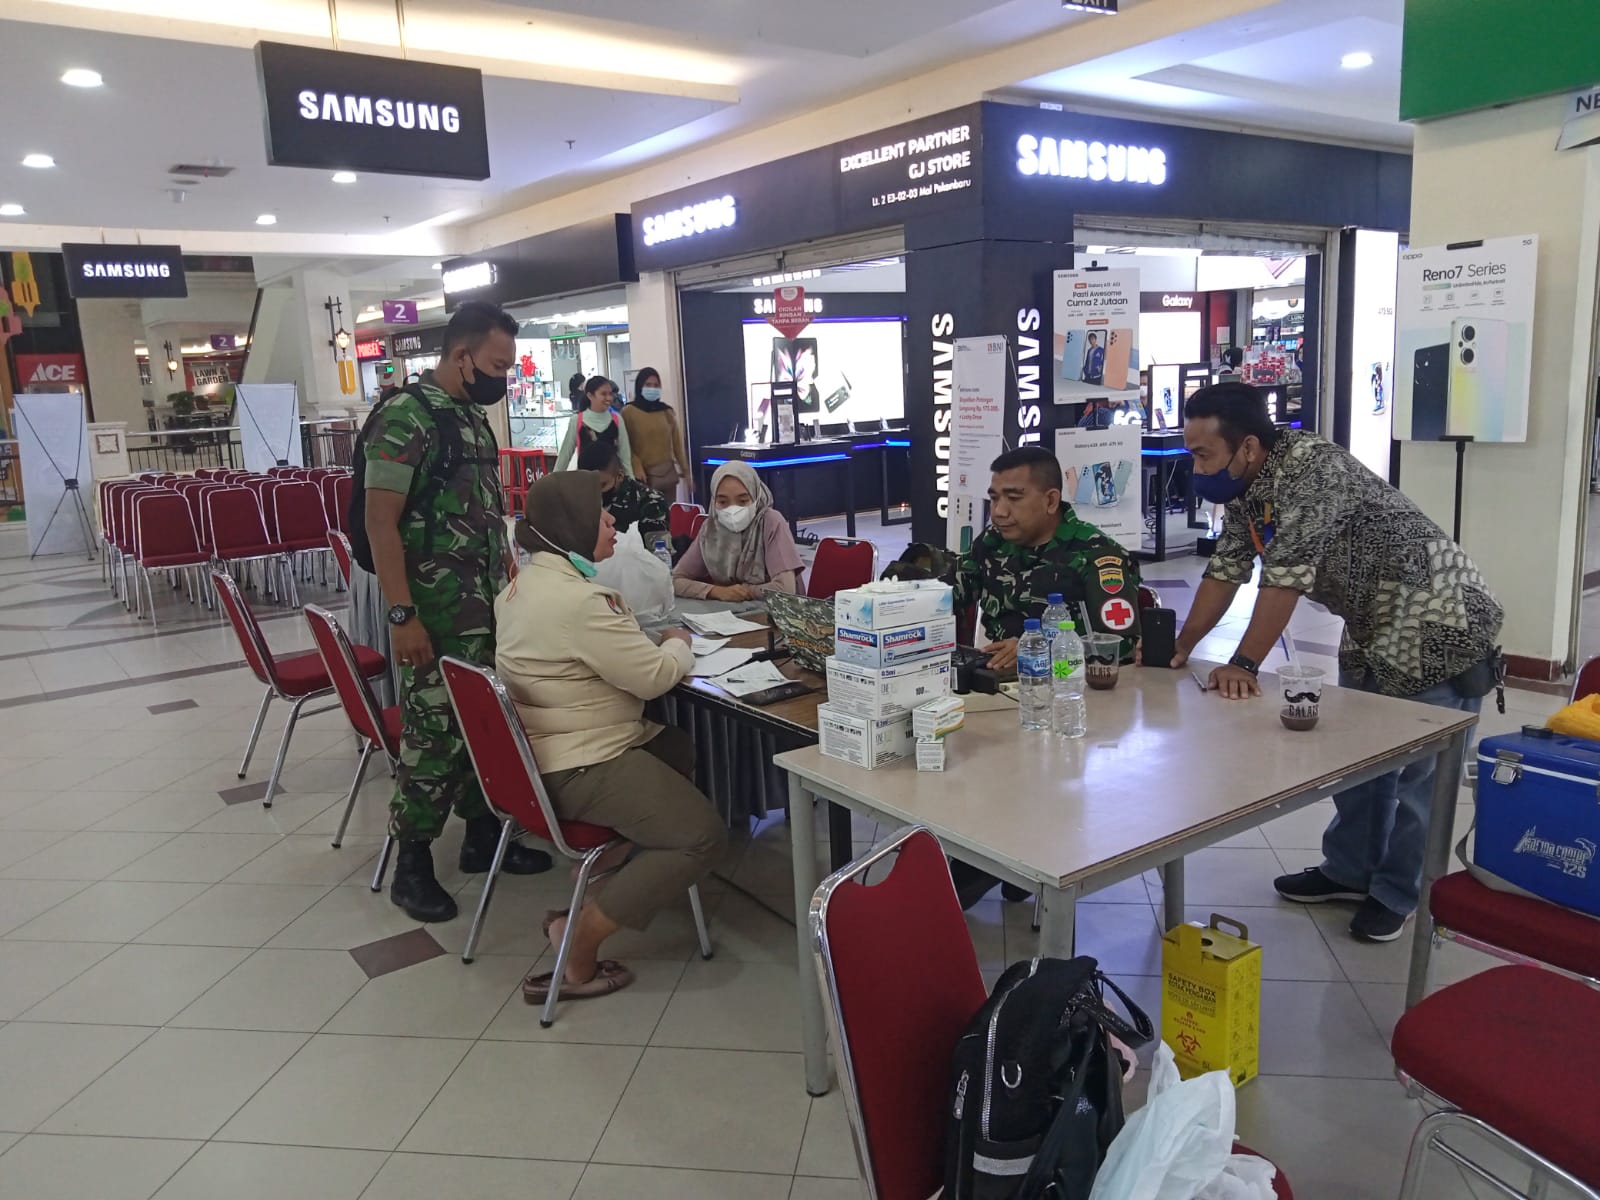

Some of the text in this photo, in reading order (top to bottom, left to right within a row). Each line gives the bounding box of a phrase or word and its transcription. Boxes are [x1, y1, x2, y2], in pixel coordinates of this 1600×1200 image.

[298, 90, 460, 133] SAMSUNG
[840, 125, 970, 172] EXCELLENT PARTNER
[908, 151, 971, 179] GJ STORE
[1016, 133, 1167, 185] SAMSUNG
[881, 195, 886, 205] 2
[887, 188, 918, 203] E3-02-03
[642, 194, 737, 247] SAMSUNG
[83, 263, 170, 278] SAMSUNG
[1423, 262, 1506, 282] Reno7 Series
[1072, 290, 1122, 298] Pasti Awesome
[1162, 294, 1193, 308] Galaxy
[753, 298, 823, 314] SANG
[1067, 298, 1128, 307] Cuma 2 Jutaan
[394, 304, 407, 319] 2
[219, 337, 228, 348] 2
[30, 363, 75, 381] ACE
[194, 367, 217, 378] LAWN
[196, 376, 228, 386] GARDEN
[839, 629, 874, 643] Shamrock
[884, 629, 922, 644] Shamrock
[1168, 972, 1216, 997] SAFETY BOX
